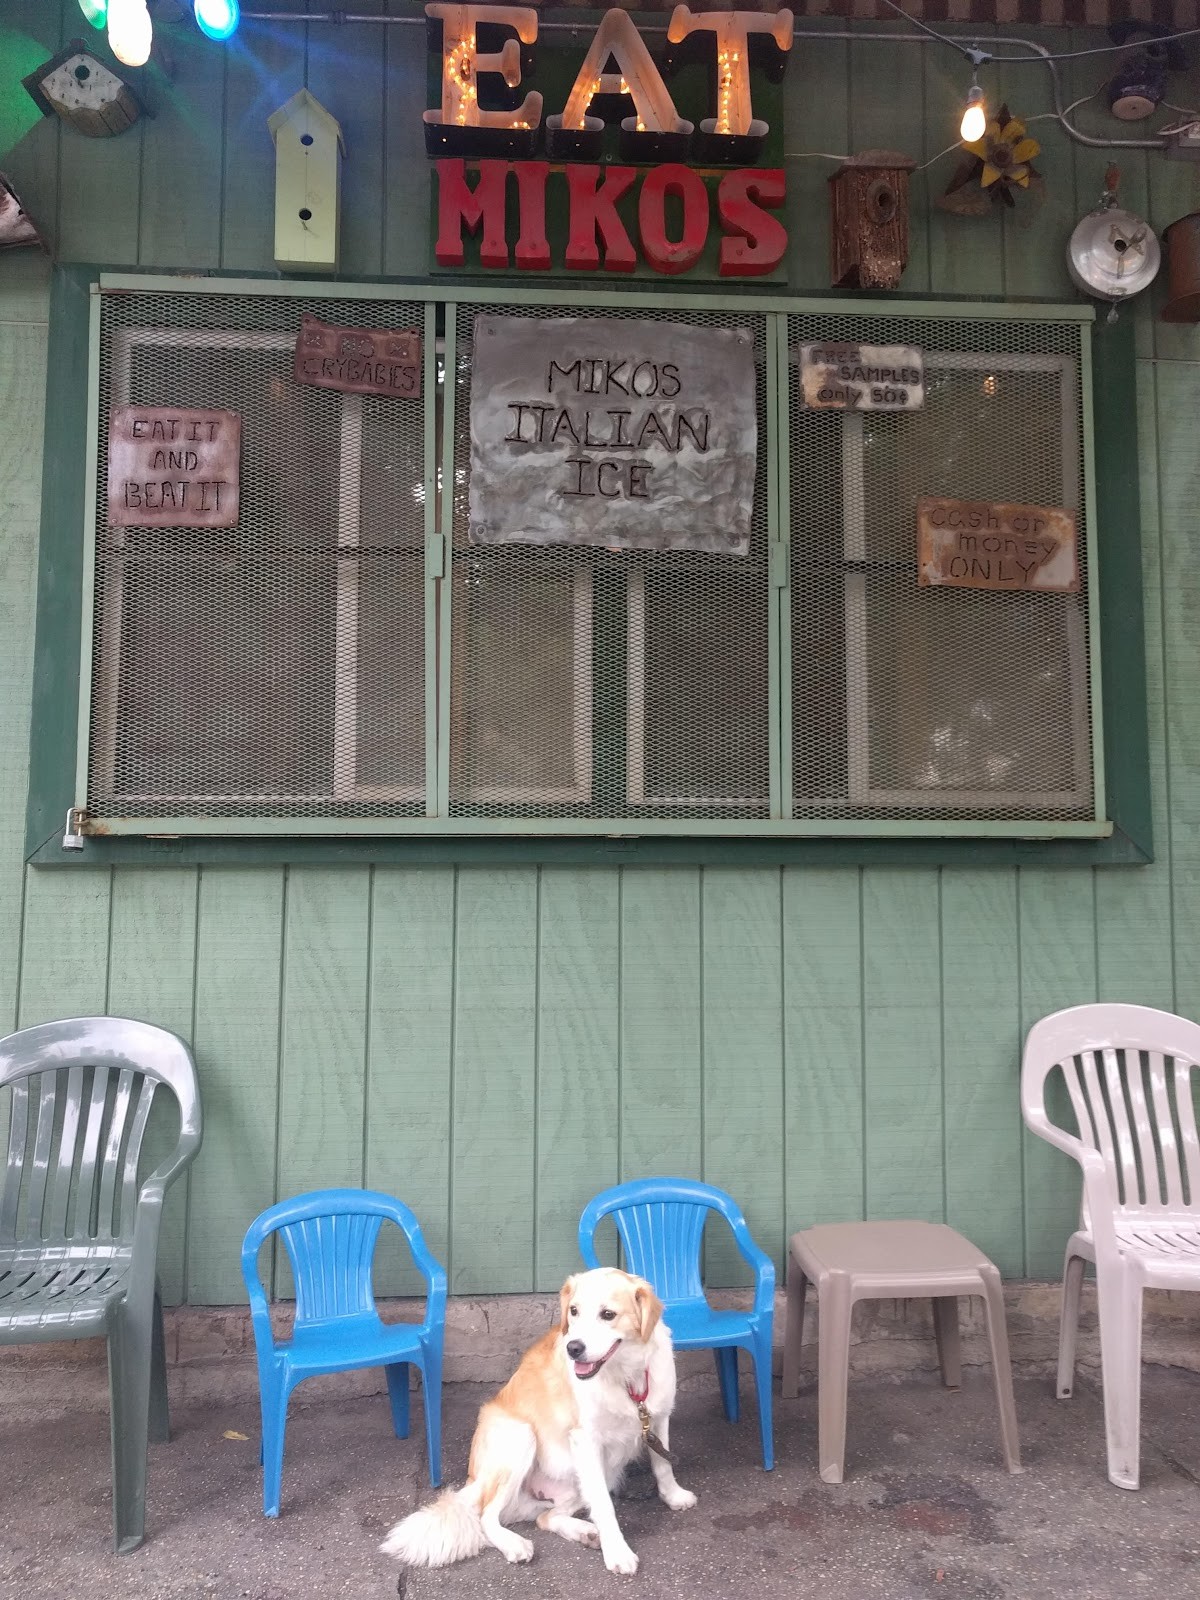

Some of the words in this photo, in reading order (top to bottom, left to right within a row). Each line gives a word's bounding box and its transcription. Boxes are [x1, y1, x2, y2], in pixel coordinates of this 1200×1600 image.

[424, 4, 794, 135] EAT
[436, 158, 788, 276] MIKOS
[303, 358, 416, 391] CRYBABIES
[548, 359, 682, 397] MIKOS
[840, 366, 920, 384] SAMPLES
[133, 419, 180, 440] EAT
[188, 421, 220, 442] IT
[504, 404, 709, 451] ITALIAN
[153, 450, 198, 471] AND
[563, 460, 653, 497] ICE
[124, 480, 190, 508] BEAT
[195, 481, 226, 511] IT
[1013, 517, 1045, 532] or
[950, 556, 1036, 583] ONLY
